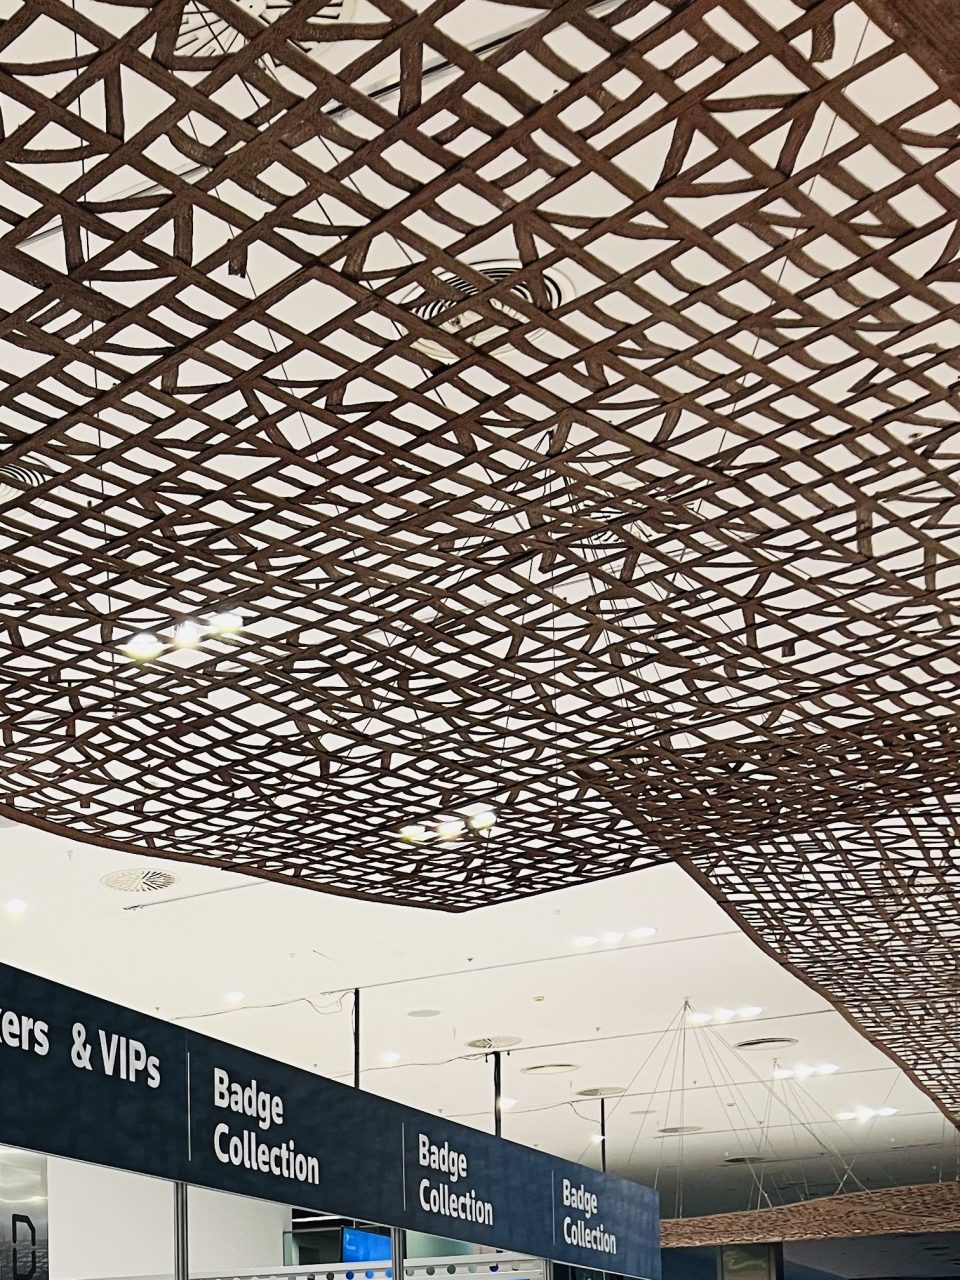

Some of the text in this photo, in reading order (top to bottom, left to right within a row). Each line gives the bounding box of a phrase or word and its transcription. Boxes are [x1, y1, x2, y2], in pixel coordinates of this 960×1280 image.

[71, 1022, 93, 1071] &
[98, 1030, 161, 1089] VIPs
[214, 1067, 284, 1130] Badge
[213, 1122, 320, 1185] Collection
[418, 1133, 467, 1182] Badge
[419, 1178, 493, 1226] Collection
[562, 1178, 598, 1218] Badge
[563, 1216, 617, 1255] Collection
